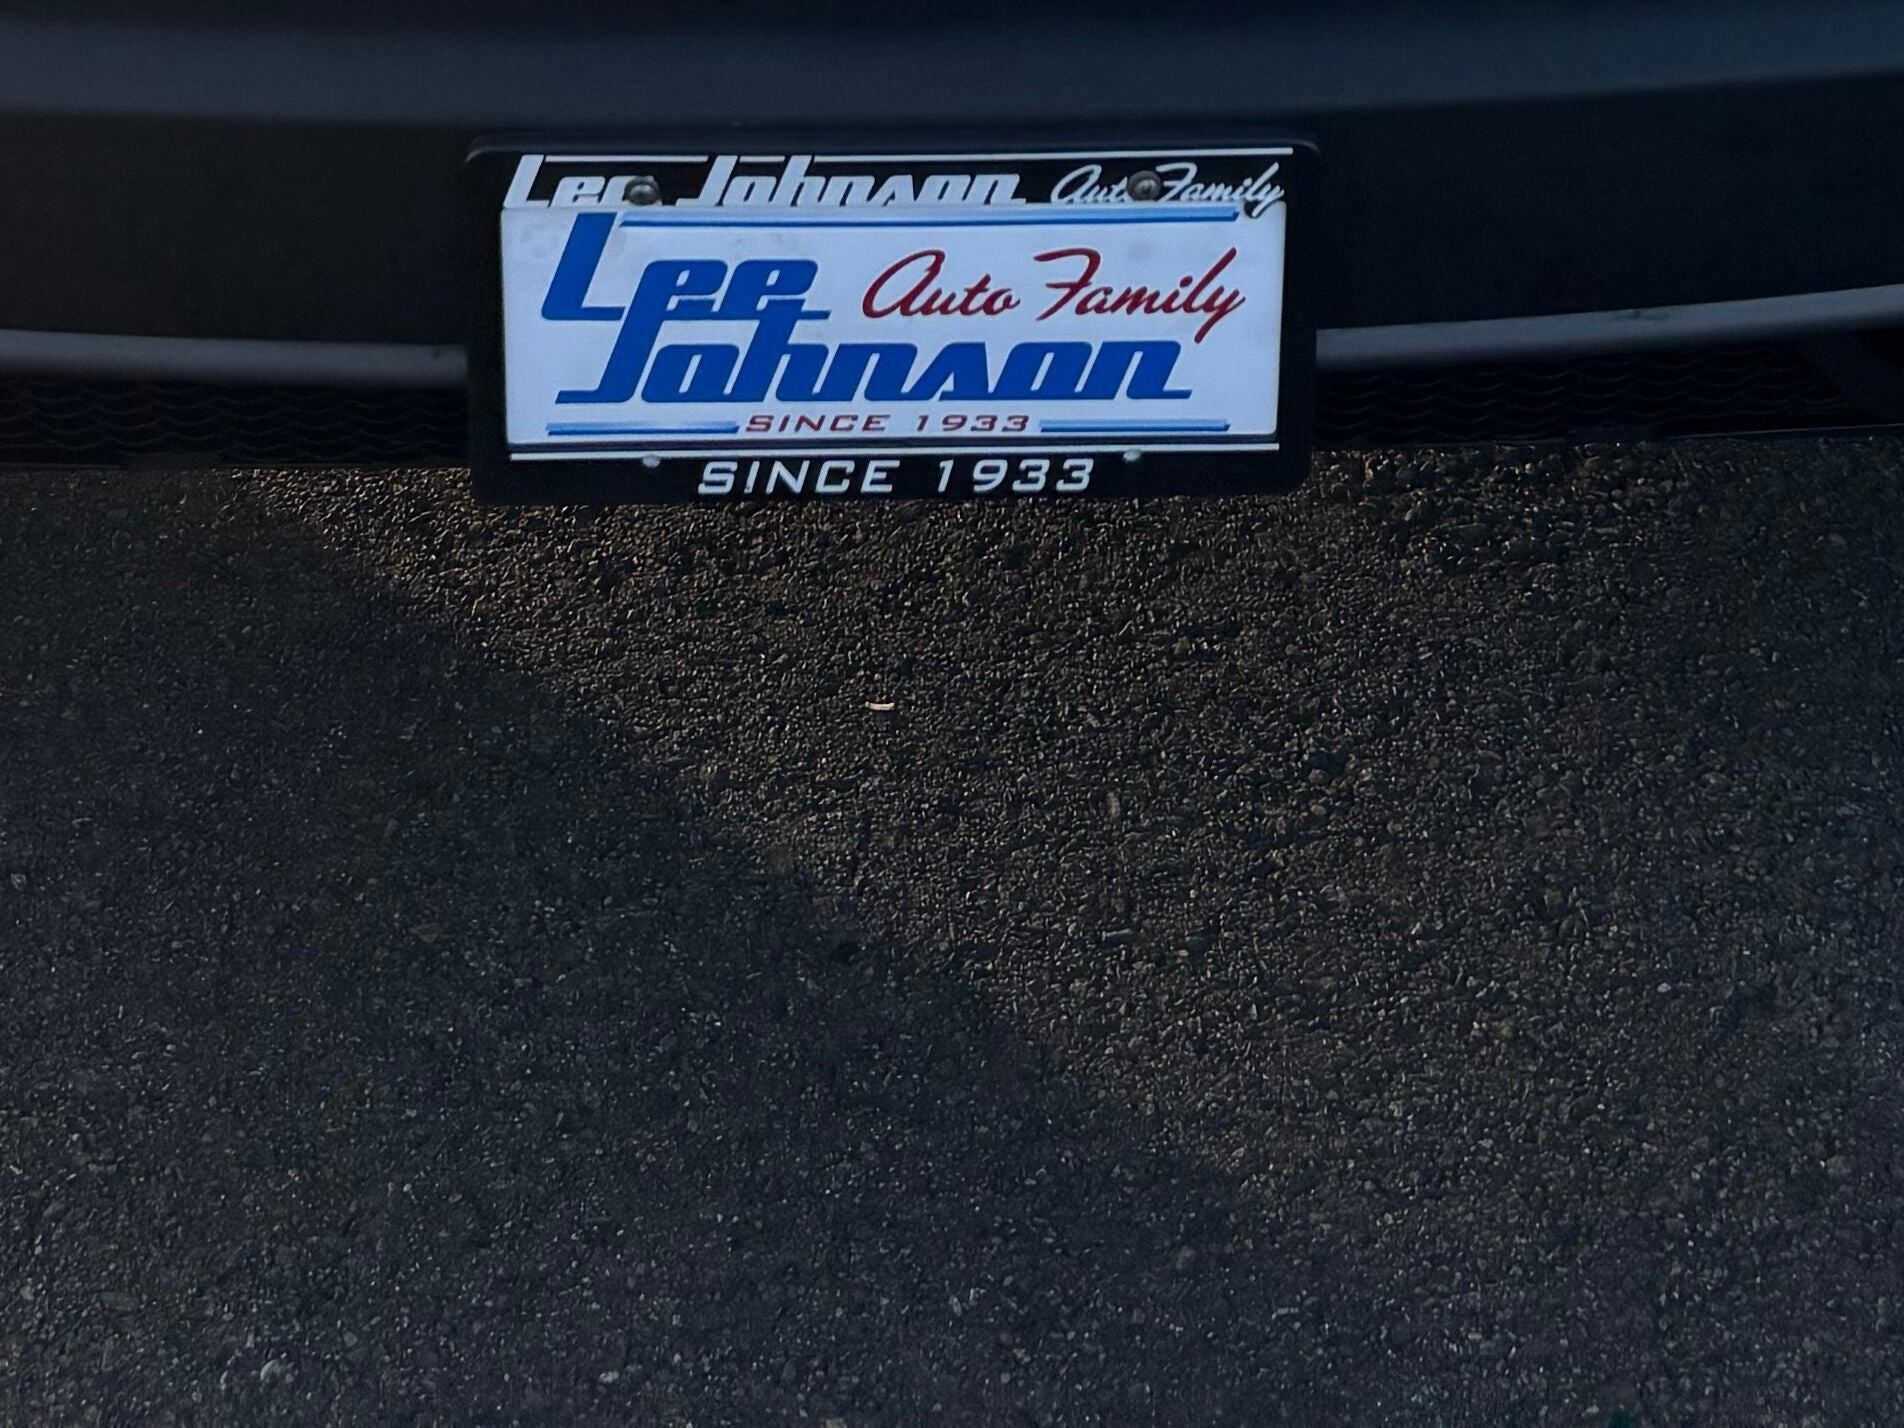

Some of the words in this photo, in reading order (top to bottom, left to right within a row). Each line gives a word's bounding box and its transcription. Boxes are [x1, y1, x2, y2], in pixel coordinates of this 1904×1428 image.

[675, 154, 1027, 206] Johnson
[1051, 164, 1158, 204] Aut
[1155, 161, 1286, 217] Family
[541, 212, 831, 321] Lee
[862, 250, 1020, 320] Auto
[1032, 247, 1247, 344] Family
[554, 302, 1192, 404] Johnson
[746, 414, 892, 432] SINCE
[916, 414, 1031, 432] 1933
[697, 459, 899, 495] SINCE
[936, 457, 1095, 494] 1933
